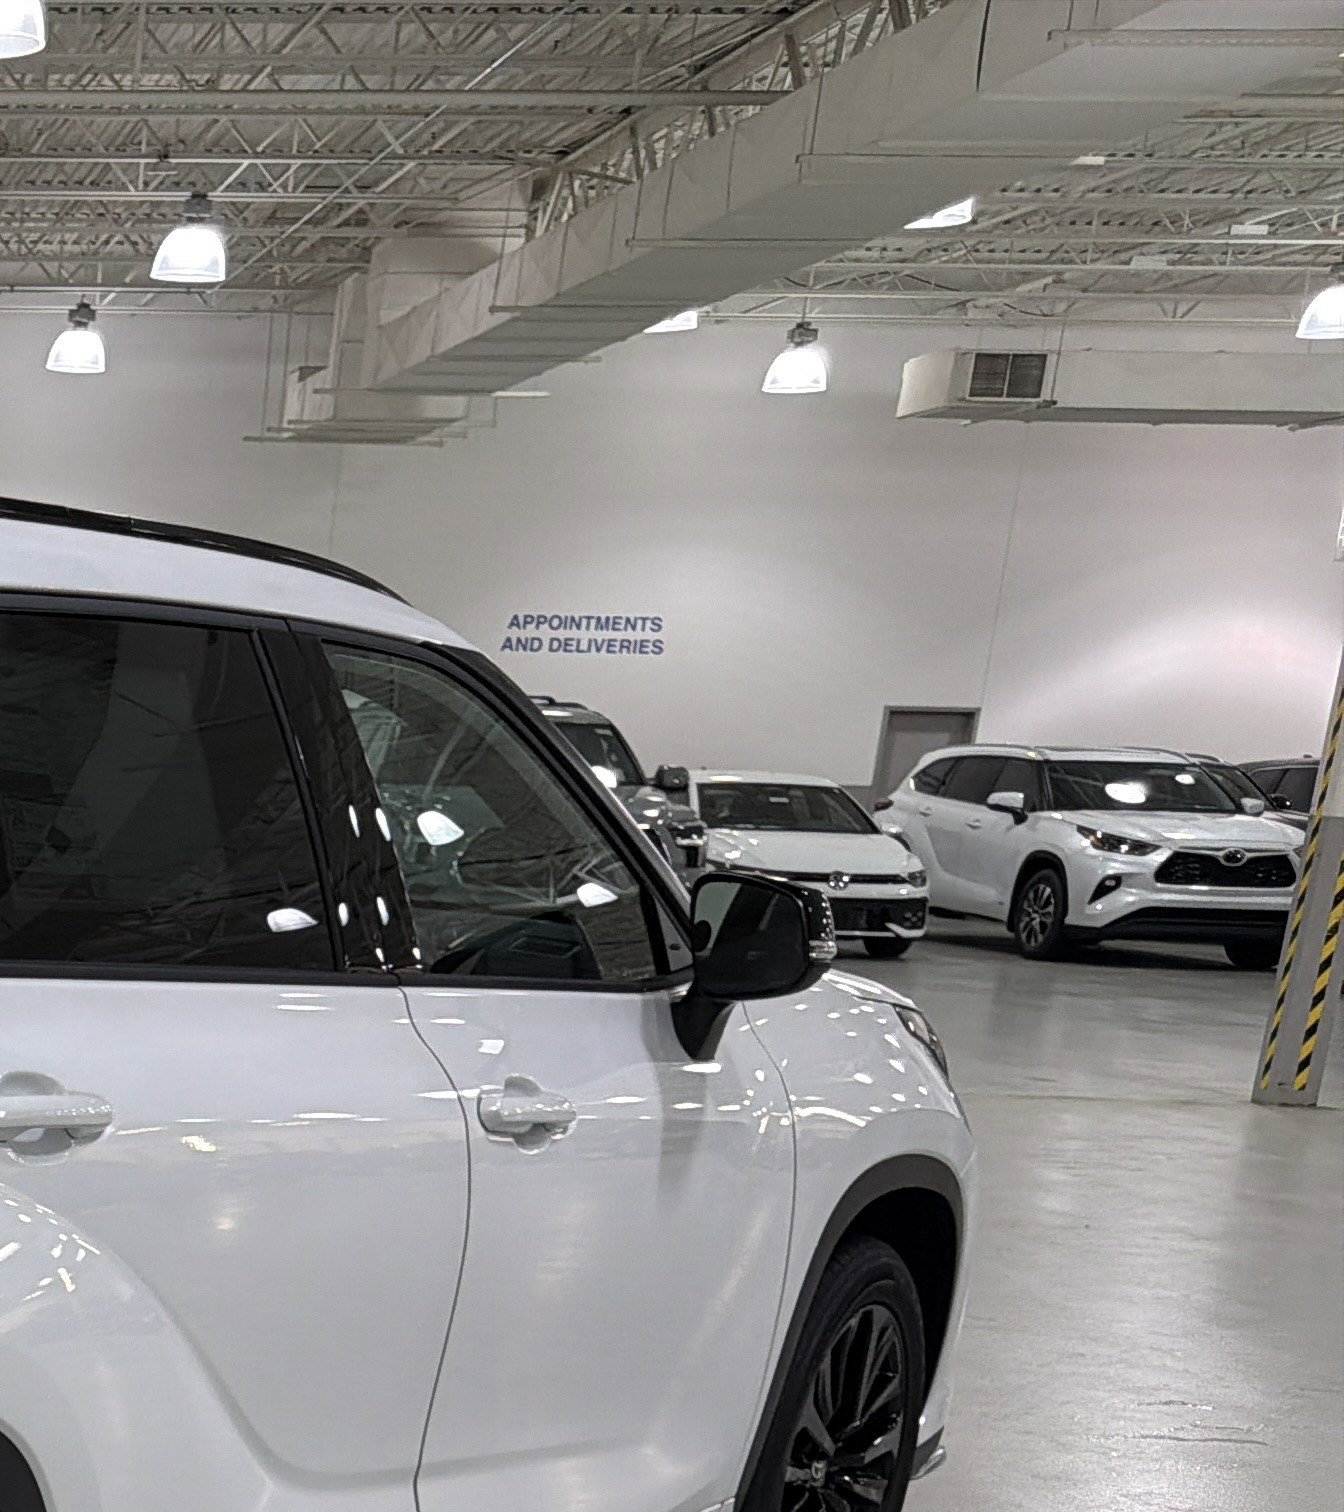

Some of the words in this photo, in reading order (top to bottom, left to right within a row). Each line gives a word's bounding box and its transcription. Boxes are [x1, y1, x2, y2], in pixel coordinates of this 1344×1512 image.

[507, 614, 663, 633] APPOINTMENTS
[500, 636, 543, 652] AND
[548, 638, 664, 655] DELIVERIES
